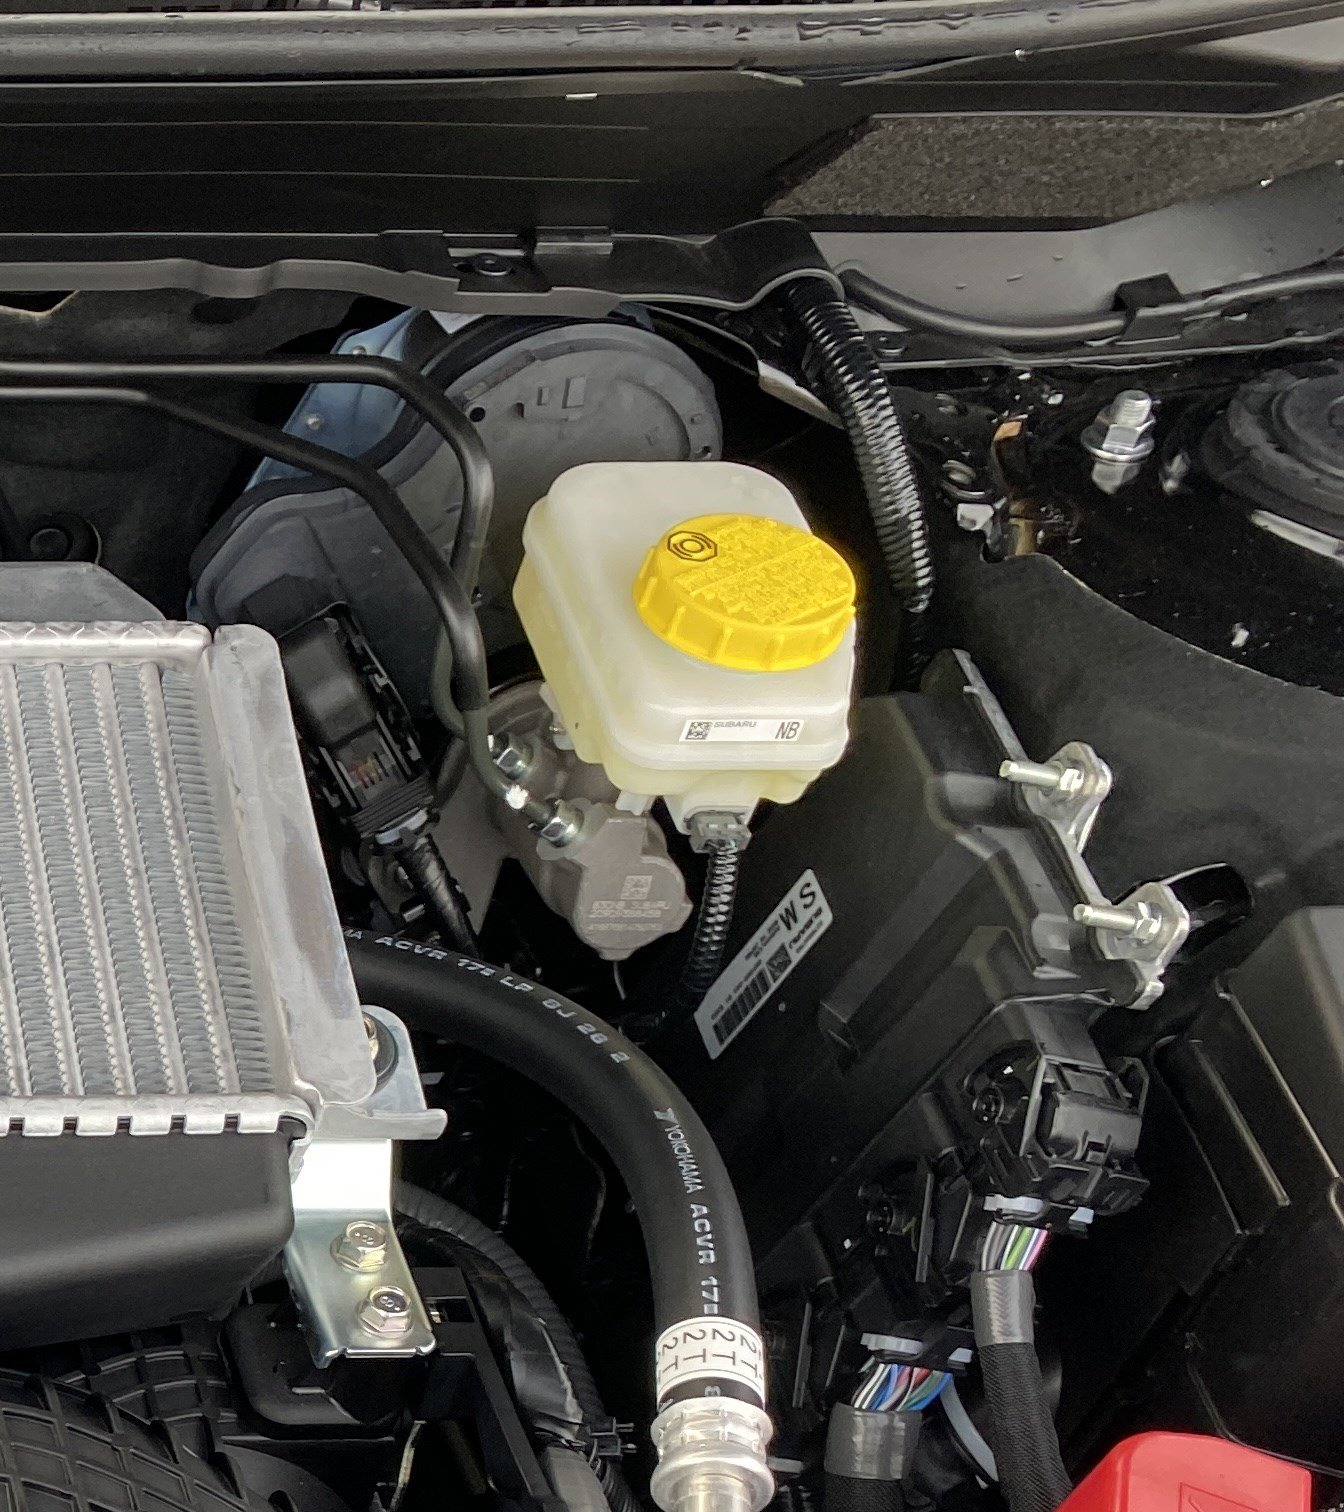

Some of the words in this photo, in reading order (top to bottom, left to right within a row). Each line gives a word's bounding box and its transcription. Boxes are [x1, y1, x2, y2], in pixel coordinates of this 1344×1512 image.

[713, 720, 759, 728] SUBARU
[775, 721, 801, 740] NB
[665, 1124, 705, 1194] YOKOHAMA
[690, 1203, 716, 1264] ACVR
